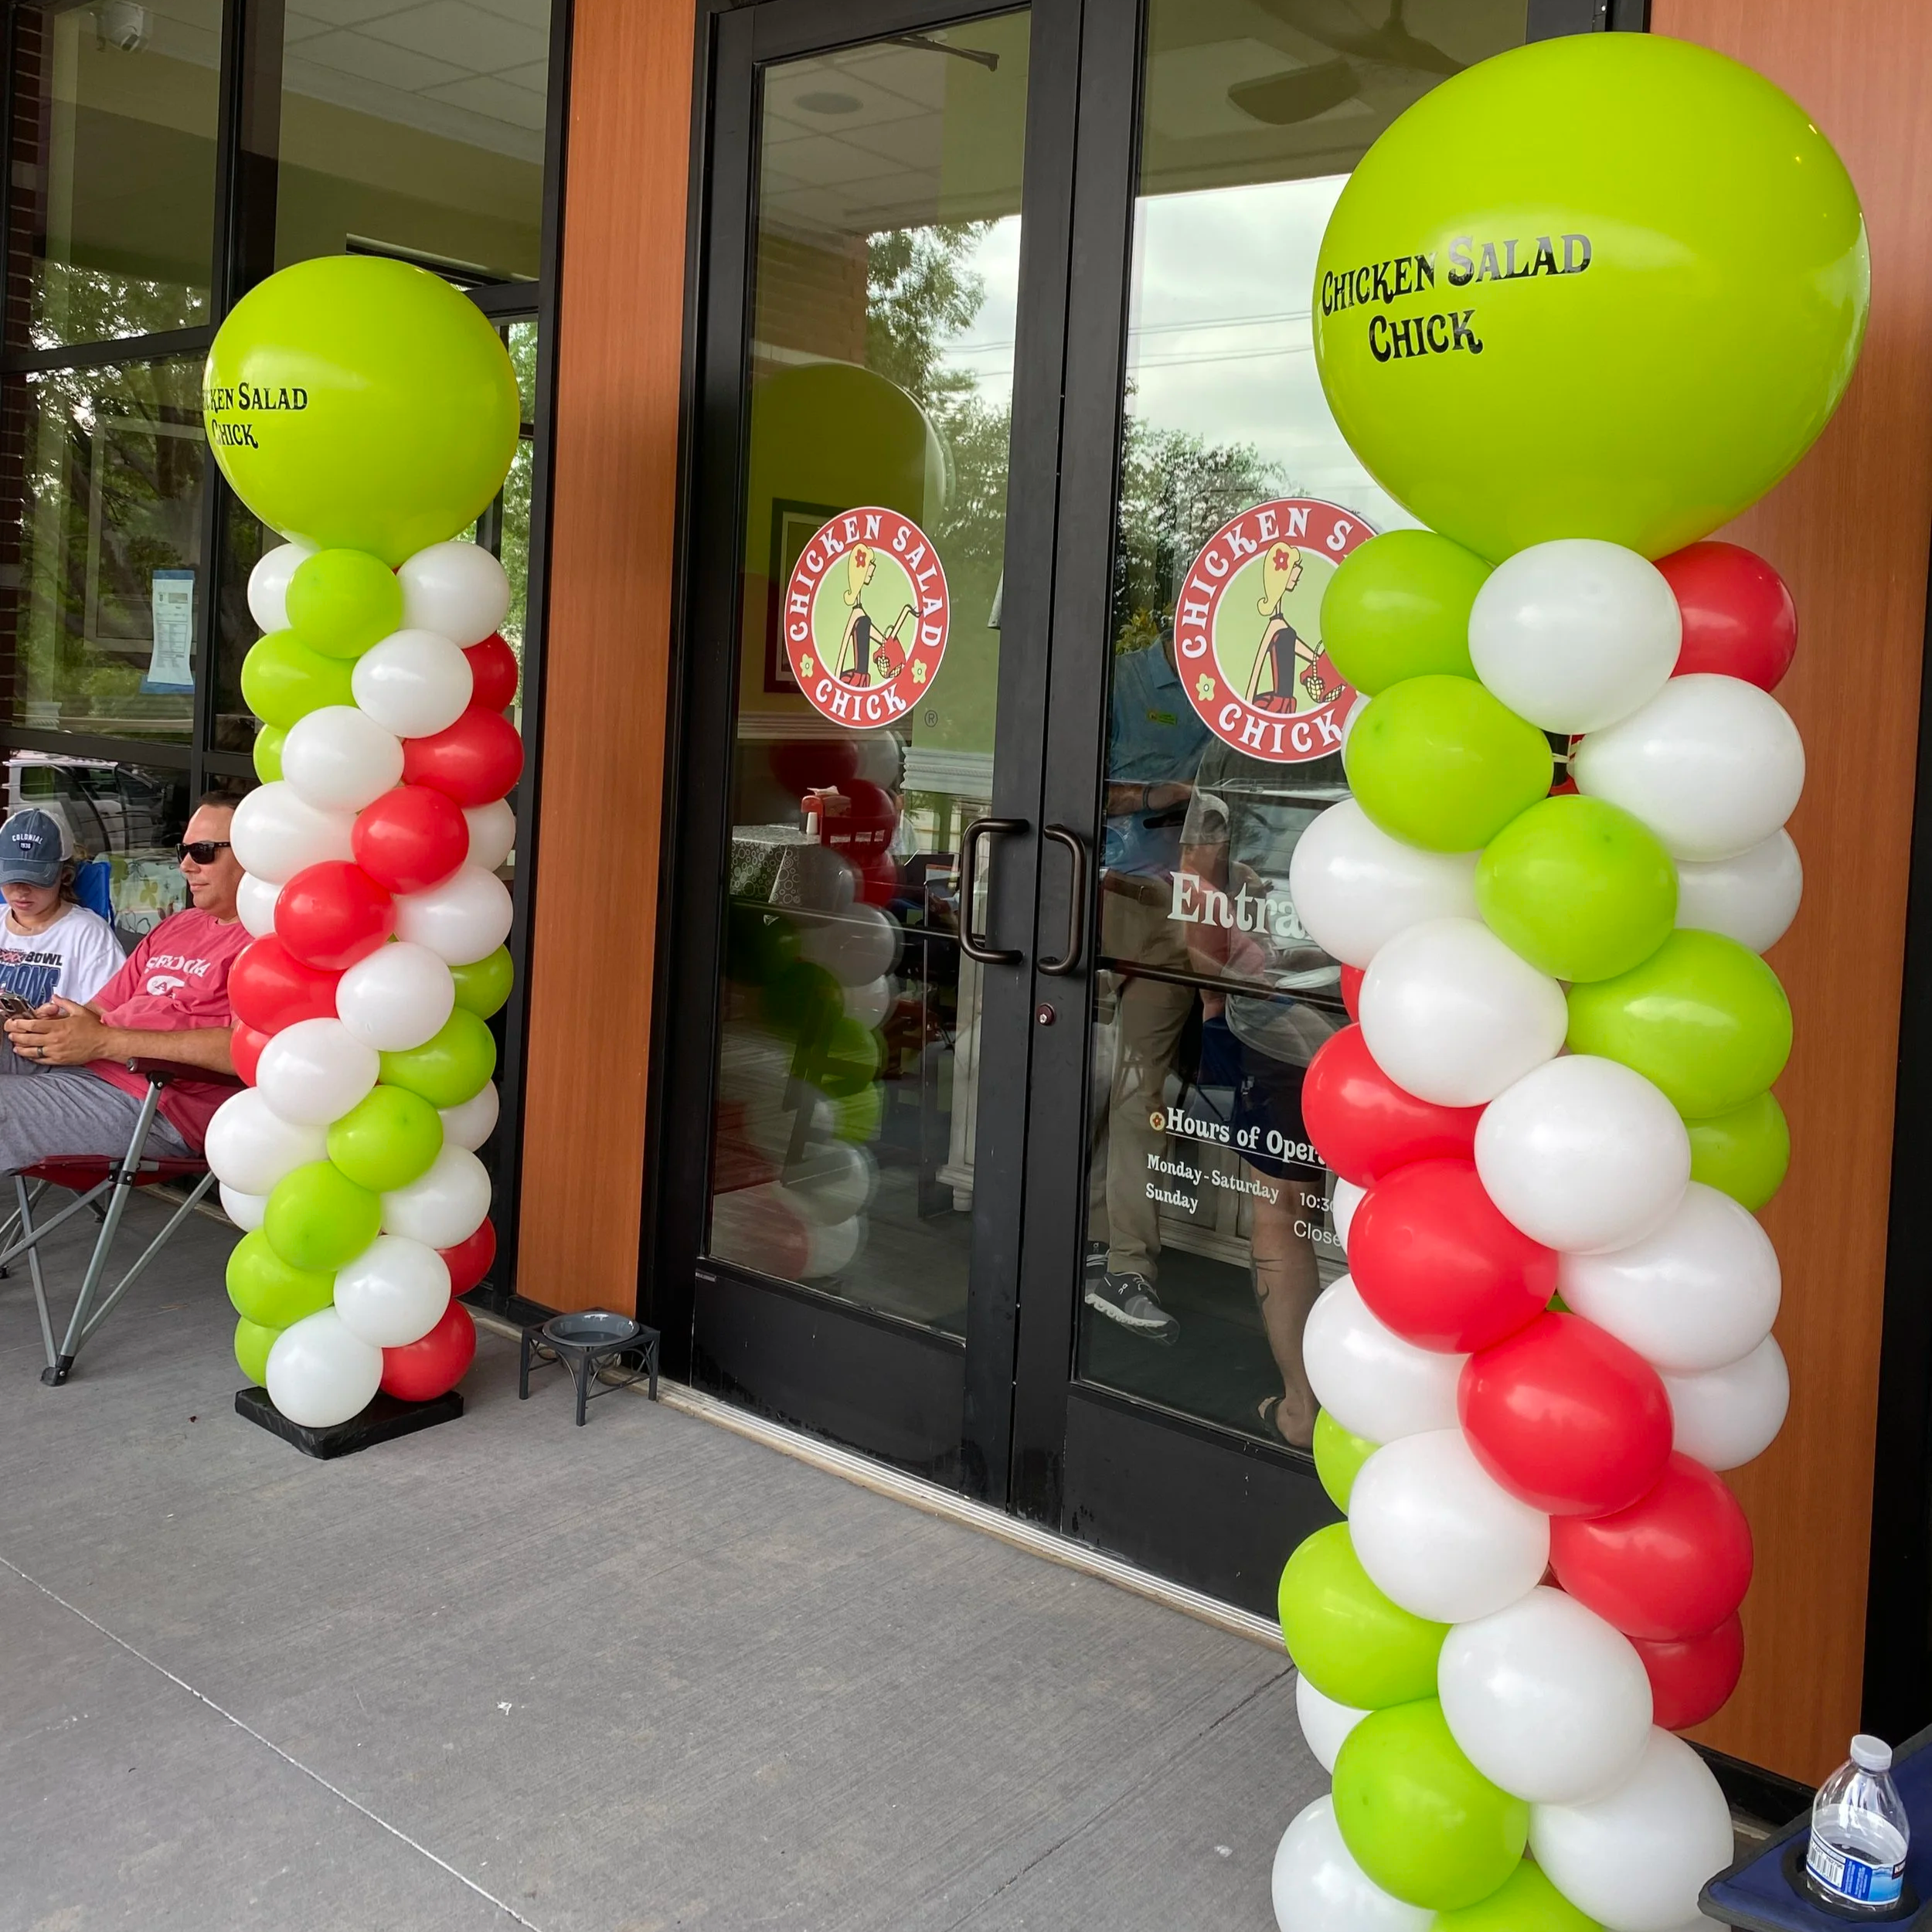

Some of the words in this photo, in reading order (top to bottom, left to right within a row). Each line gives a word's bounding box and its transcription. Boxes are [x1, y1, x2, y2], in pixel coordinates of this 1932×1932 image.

[1322, 252, 1437, 317] CHICKEN
[1447, 234, 1592, 287] SALAD
[1369, 310, 1484, 362] CHICK
[239, 382, 308, 410] SALAD
[212, 418, 259, 449] CHICK
[790, 515, 883, 641] CHICKEN
[892, 526, 944, 647] SALAD
[1182, 507, 1312, 659] CHICKEN
[815, 679, 906, 721] CHICK
[1218, 702, 1342, 753] CHICK
[12, 833, 43, 845] COLONIAL
[1167, 871, 1312, 940] Entra
[25, 951, 63, 966] BOWL
[1165, 1107, 1230, 1143] Hours
[1236, 1126, 1260, 1149] of
[1145, 1183, 1198, 1214] Sunday
